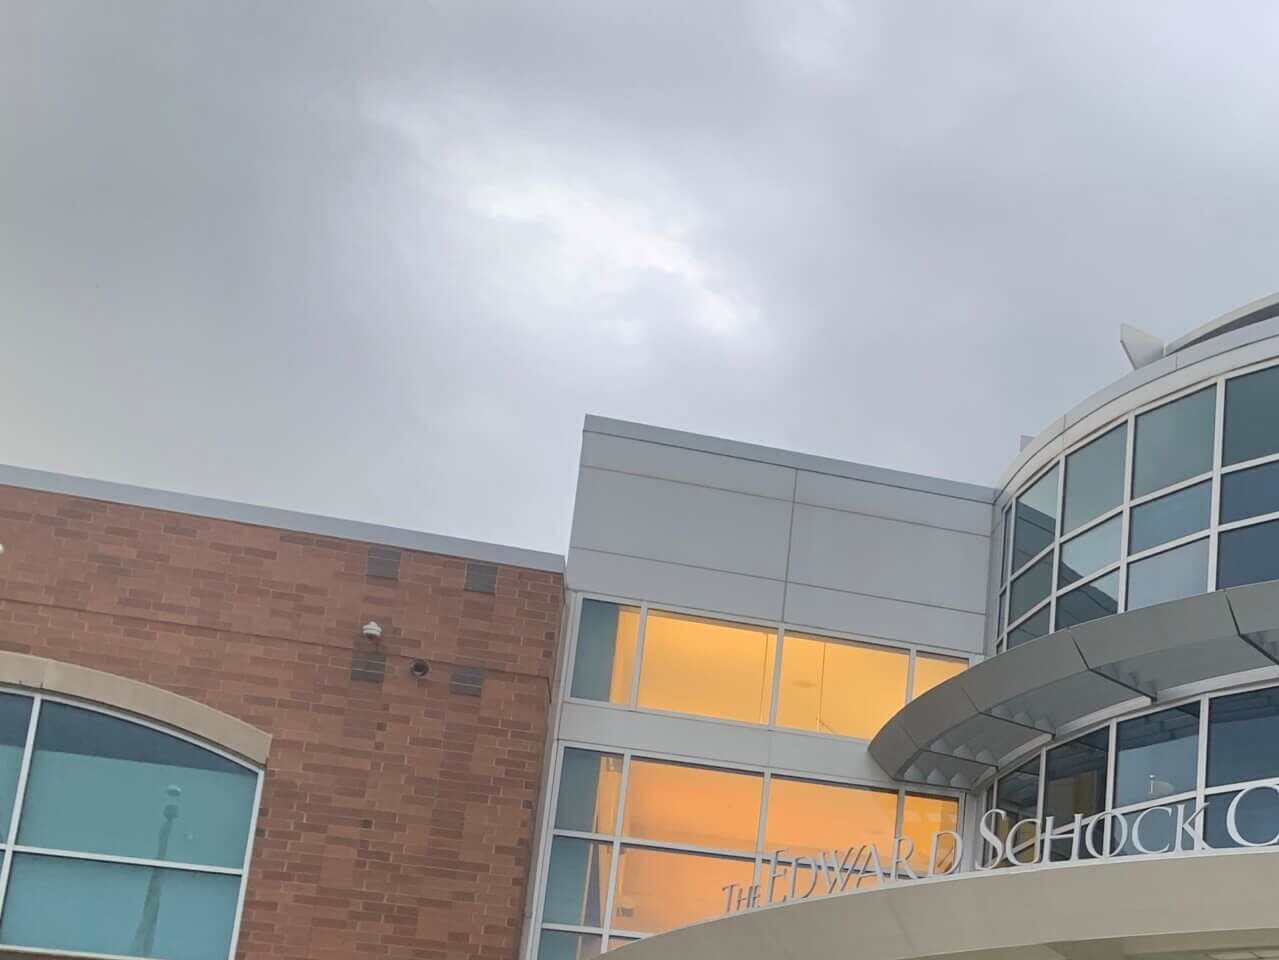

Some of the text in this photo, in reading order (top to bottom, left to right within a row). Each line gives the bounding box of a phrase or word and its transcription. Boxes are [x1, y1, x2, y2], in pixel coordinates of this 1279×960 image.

[722, 883, 760, 913] THE
[767, 829, 964, 903] EDWARD
[975, 802, 1215, 871] SCHOCK
